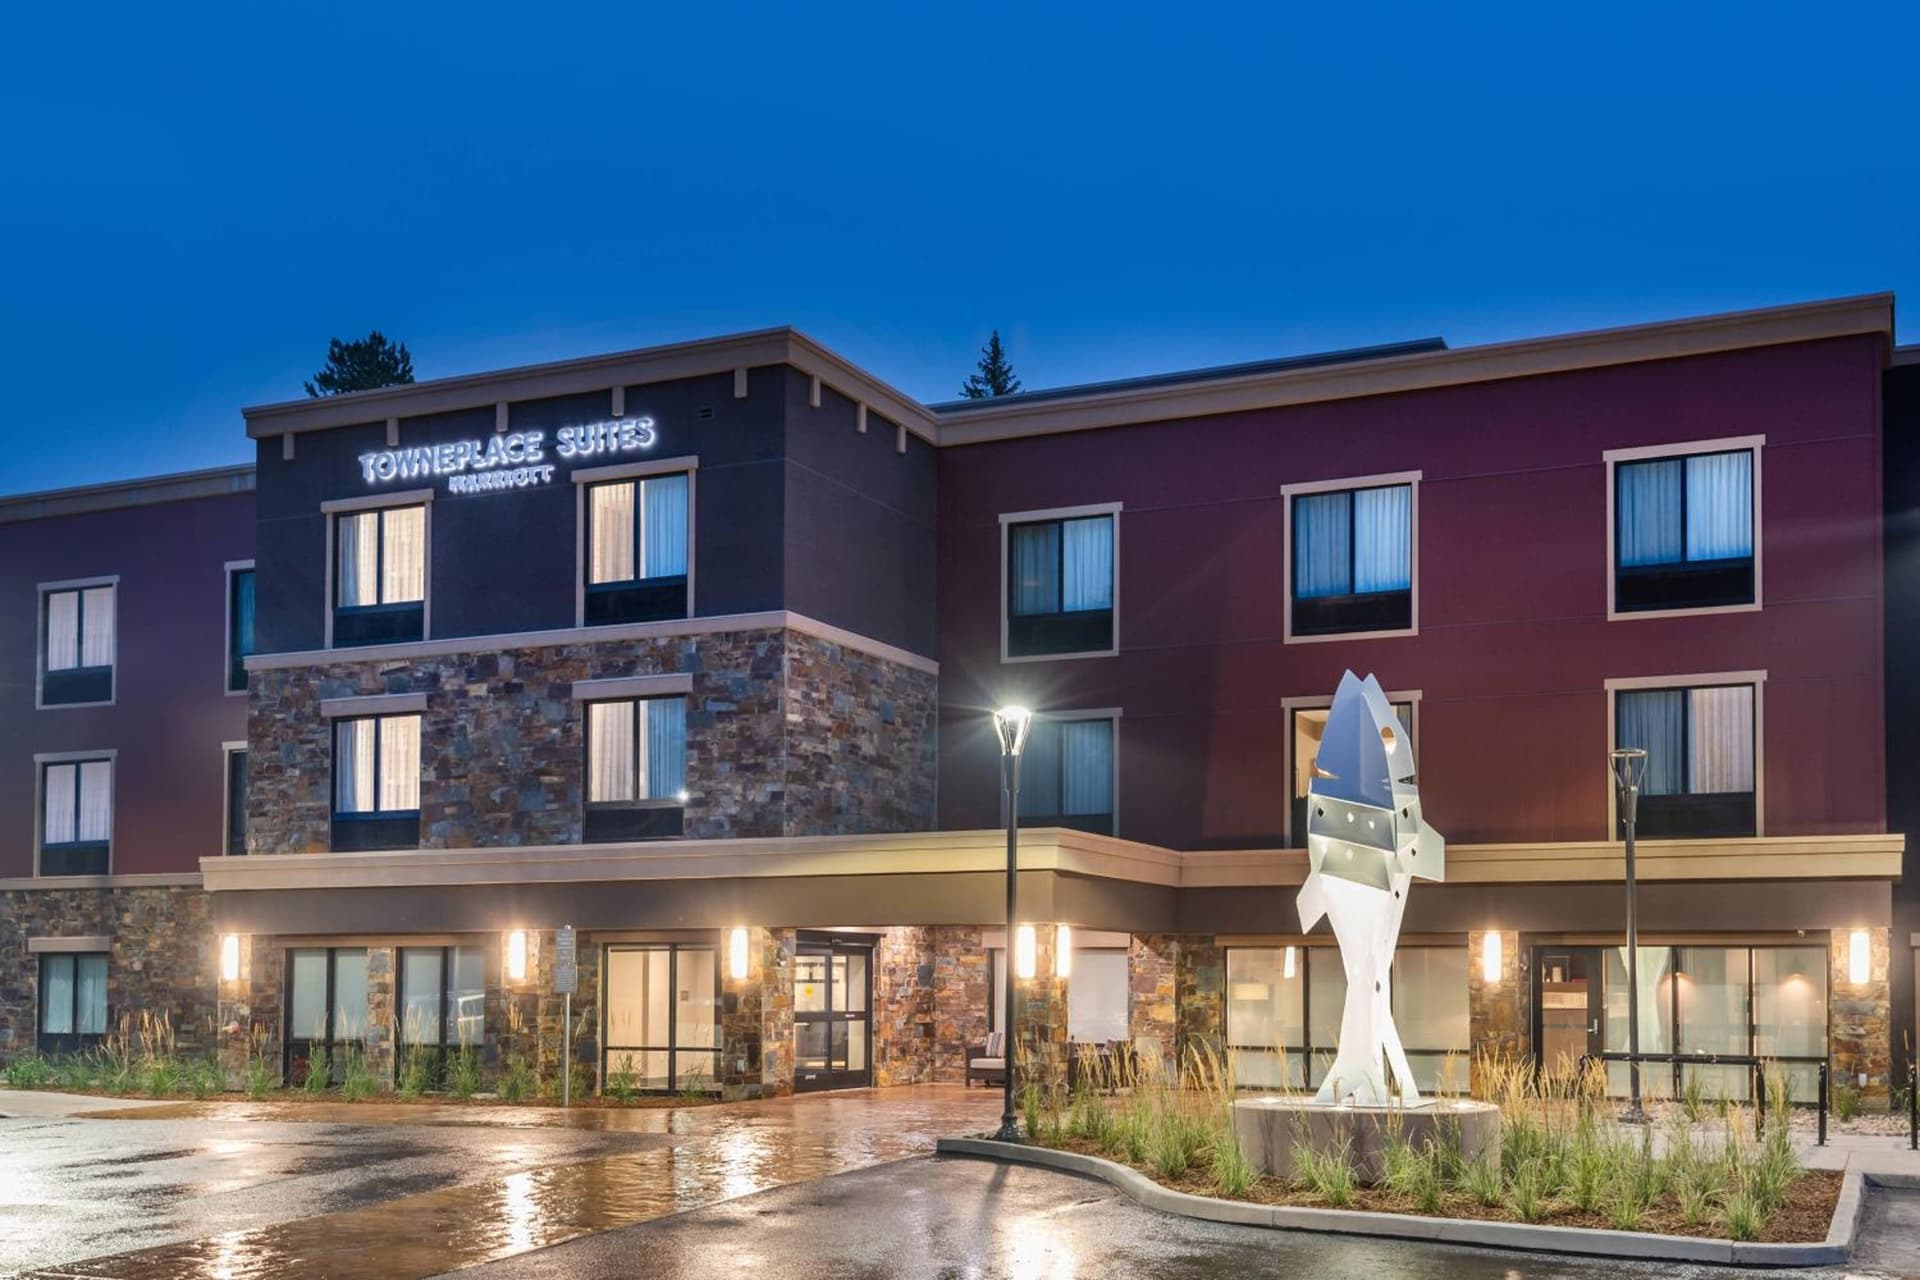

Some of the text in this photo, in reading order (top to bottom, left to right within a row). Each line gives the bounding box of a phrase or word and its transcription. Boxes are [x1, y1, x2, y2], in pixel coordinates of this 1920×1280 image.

[357, 416, 657, 482] TOWNEPLACE SUITES
[448, 465, 555, 494] MARRIOTT
